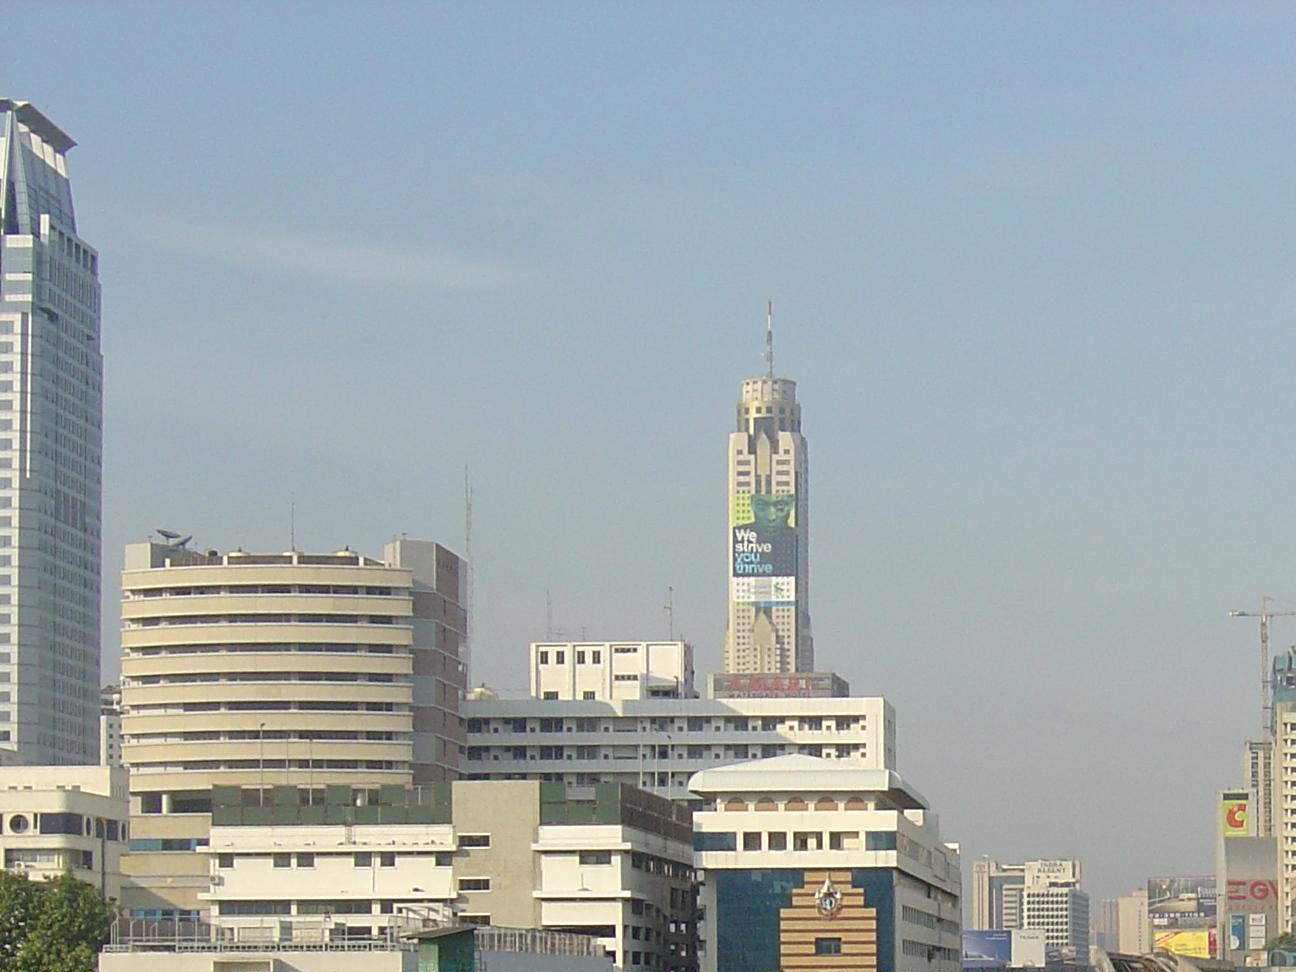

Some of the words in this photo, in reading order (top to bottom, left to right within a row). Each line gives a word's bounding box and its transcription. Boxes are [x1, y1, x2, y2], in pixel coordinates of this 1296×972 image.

[735, 529, 757, 542] We
[735, 541, 772, 552] strive
[735, 553, 760, 563] you
[735, 562, 772, 573] thrive
[729, 677, 812, 691] AMARI
